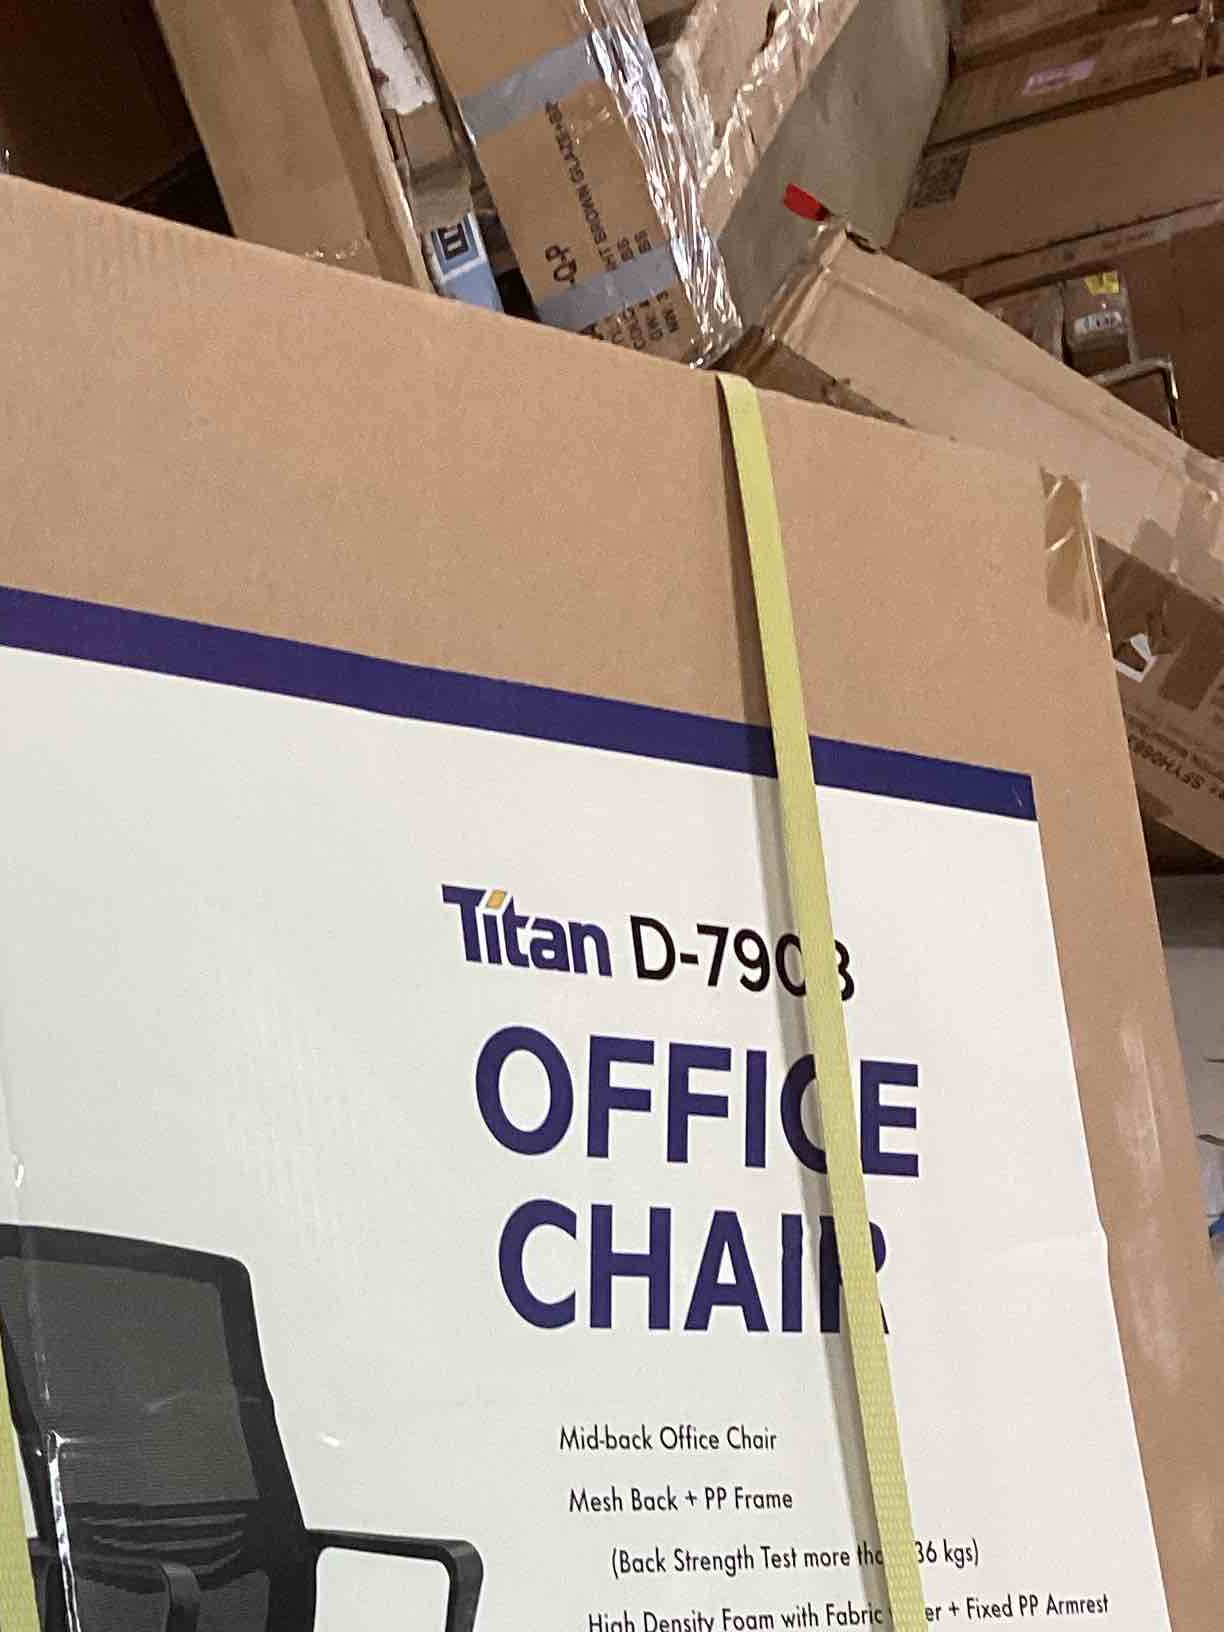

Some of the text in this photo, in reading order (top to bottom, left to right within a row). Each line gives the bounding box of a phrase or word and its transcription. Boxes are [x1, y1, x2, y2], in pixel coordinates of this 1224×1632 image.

[441, 884, 612, 976] Titan
[475, 1025, 919, 1178] OFFICE
[498, 1198, 889, 1334] CHAIR
[560, 1424, 777, 1450] Mid-back Office Chair
[569, 1485, 793, 1512] Mesh Back + PP Frame
[612, 1537, 979, 1580] (Back Strength Test more tha 36 kgs)
[721, 1608, 774, 1632] Foam
[780, 1602, 819, 1629] with
[826, 1601, 883, 1628] Fabric
[949, 1604, 960, 1617] +
[966, 1594, 1012, 1620] Fixed
[1018, 1595, 1039, 1616] PP
[1046, 1593, 1109, 1616] Armrest
